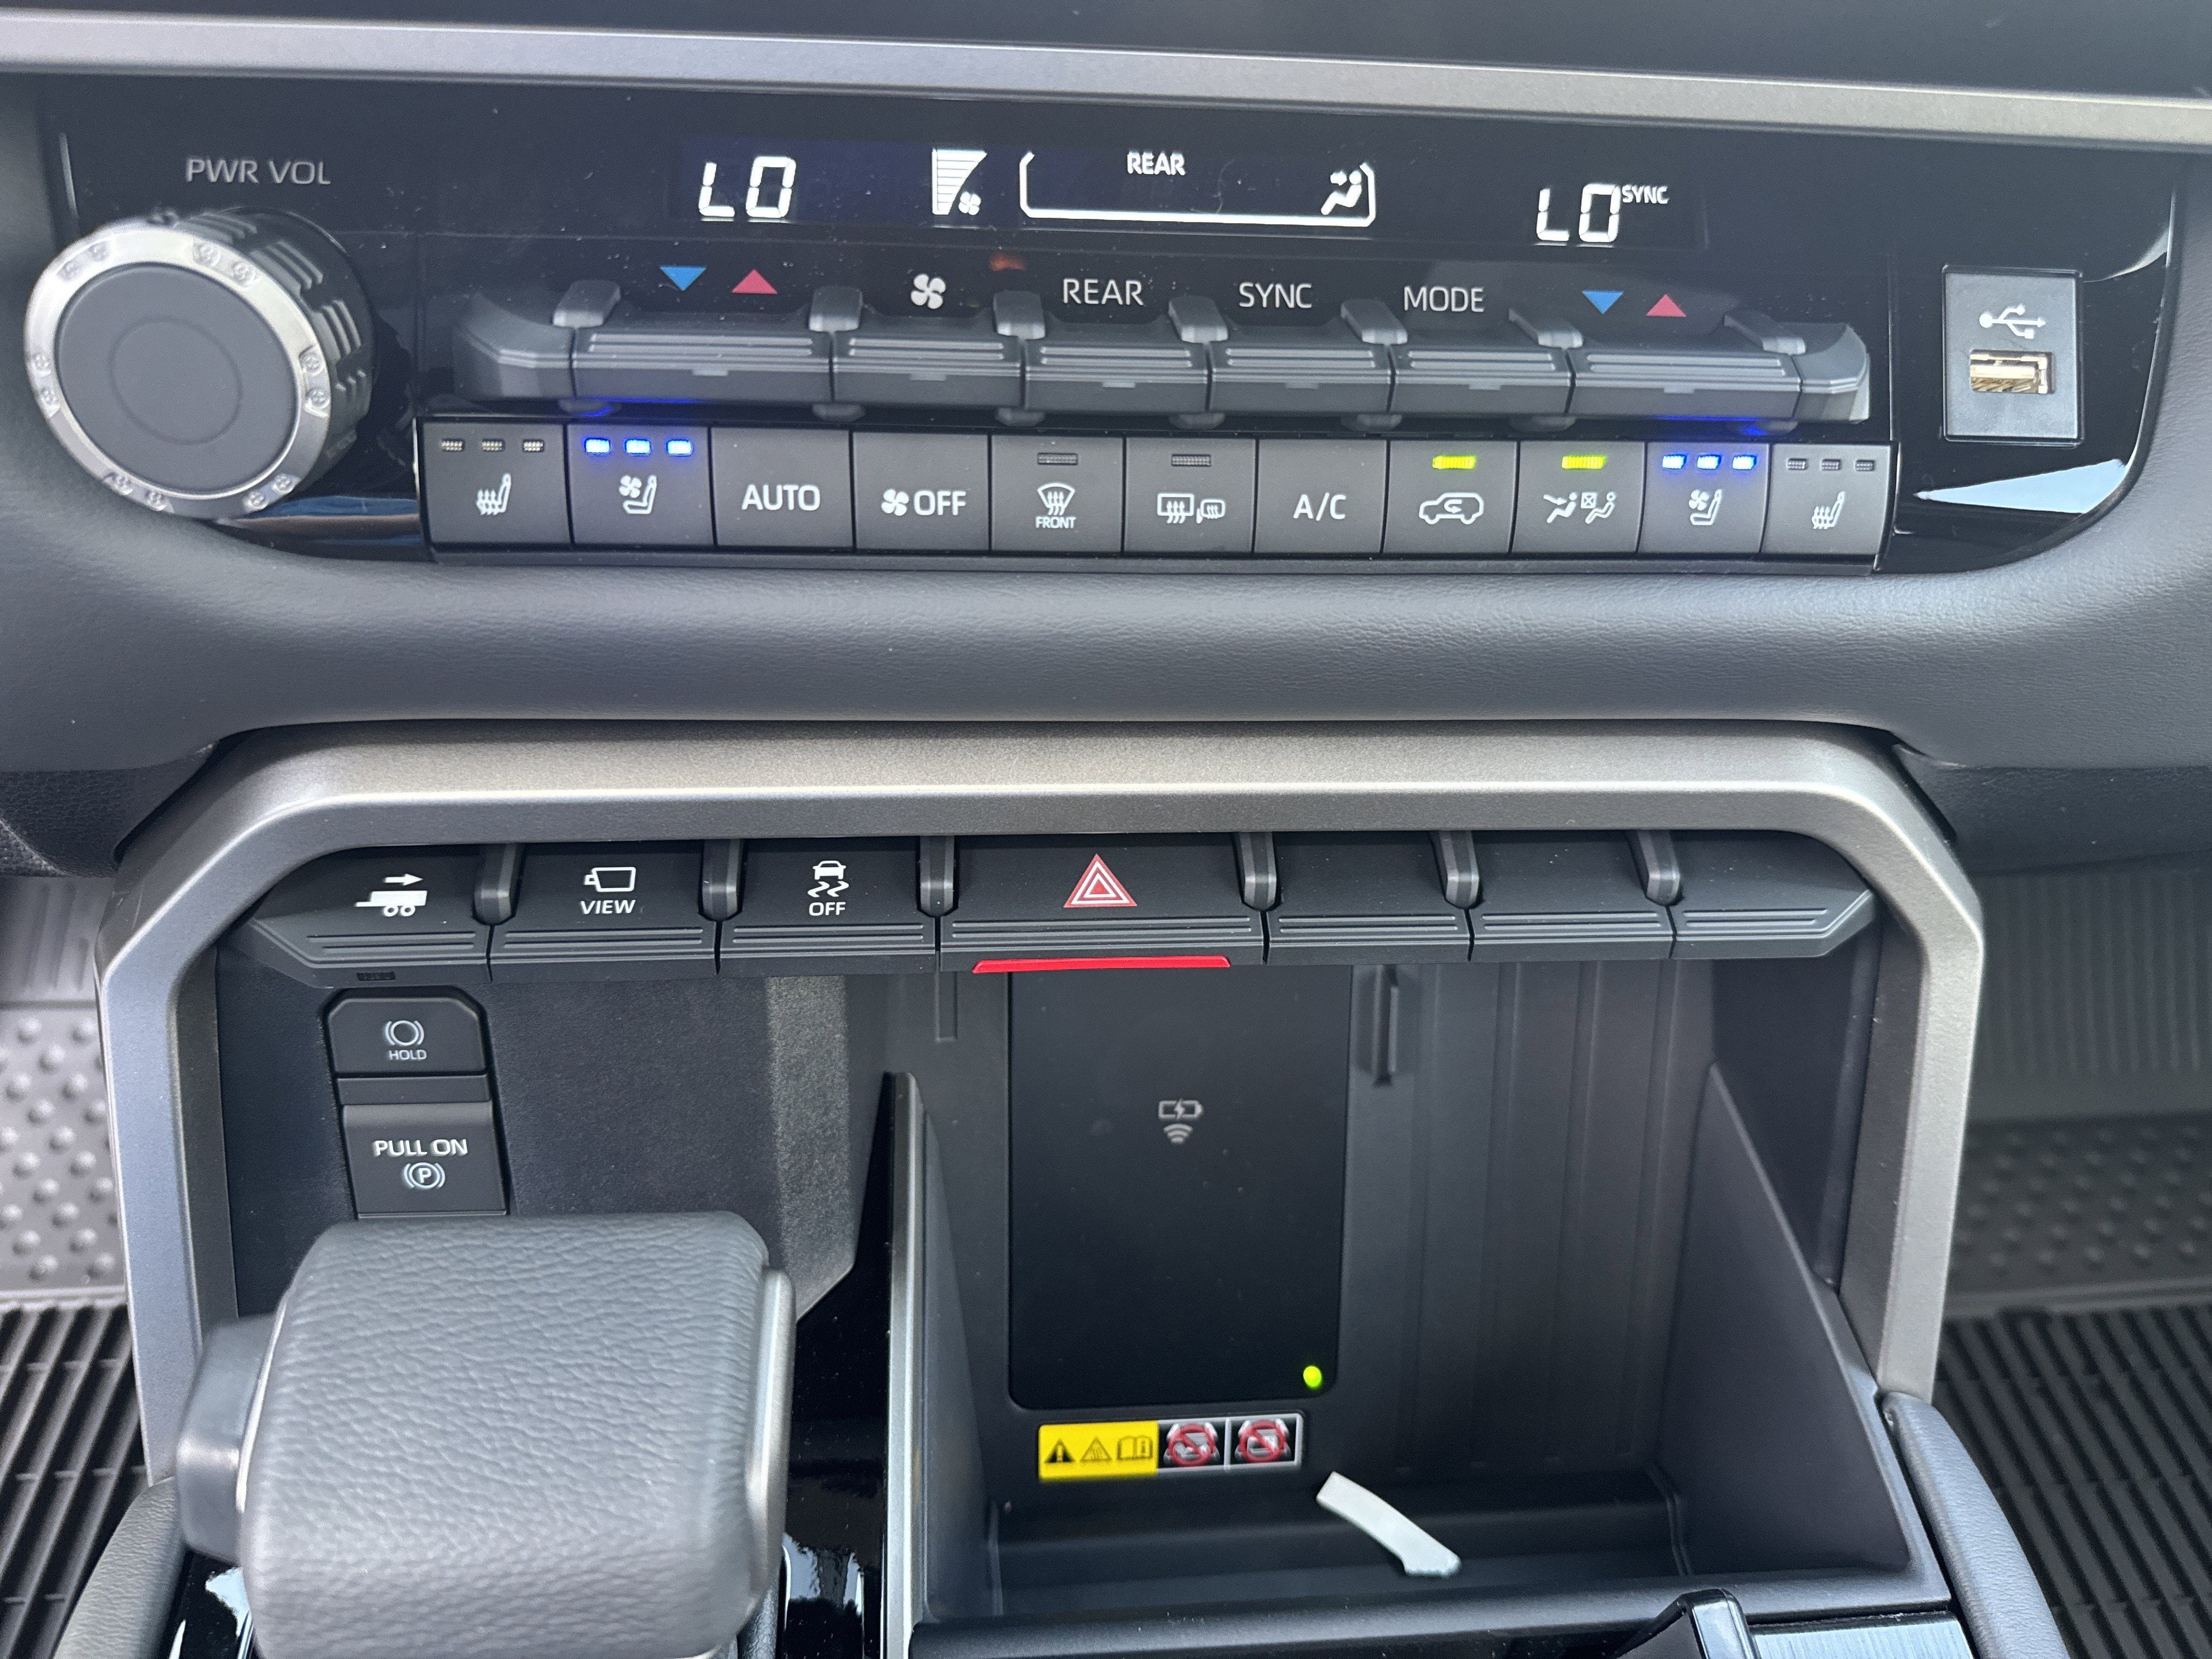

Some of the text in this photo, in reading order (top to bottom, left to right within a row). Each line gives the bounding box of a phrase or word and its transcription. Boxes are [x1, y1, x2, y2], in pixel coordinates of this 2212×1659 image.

[186, 159, 331, 184] PWR VOL
[1127, 151, 1186, 176] REAR
[1622, 184, 1669, 204] SYNC
[1063, 278, 1143, 306] REAR
[1239, 282, 1312, 308] SYNC
[1404, 286, 1484, 312] MODE
[742, 484, 820, 511] AUTO
[913, 490, 966, 516] OFF
[1293, 492, 1346, 521] A/C
[1035, 516, 1076, 529] FRONT
[580, 899, 636, 915] VIEW
[809, 901, 846, 916] OFF
[388, 1049, 427, 1060] HOLD
[373, 1139, 468, 1156] PULL ON
